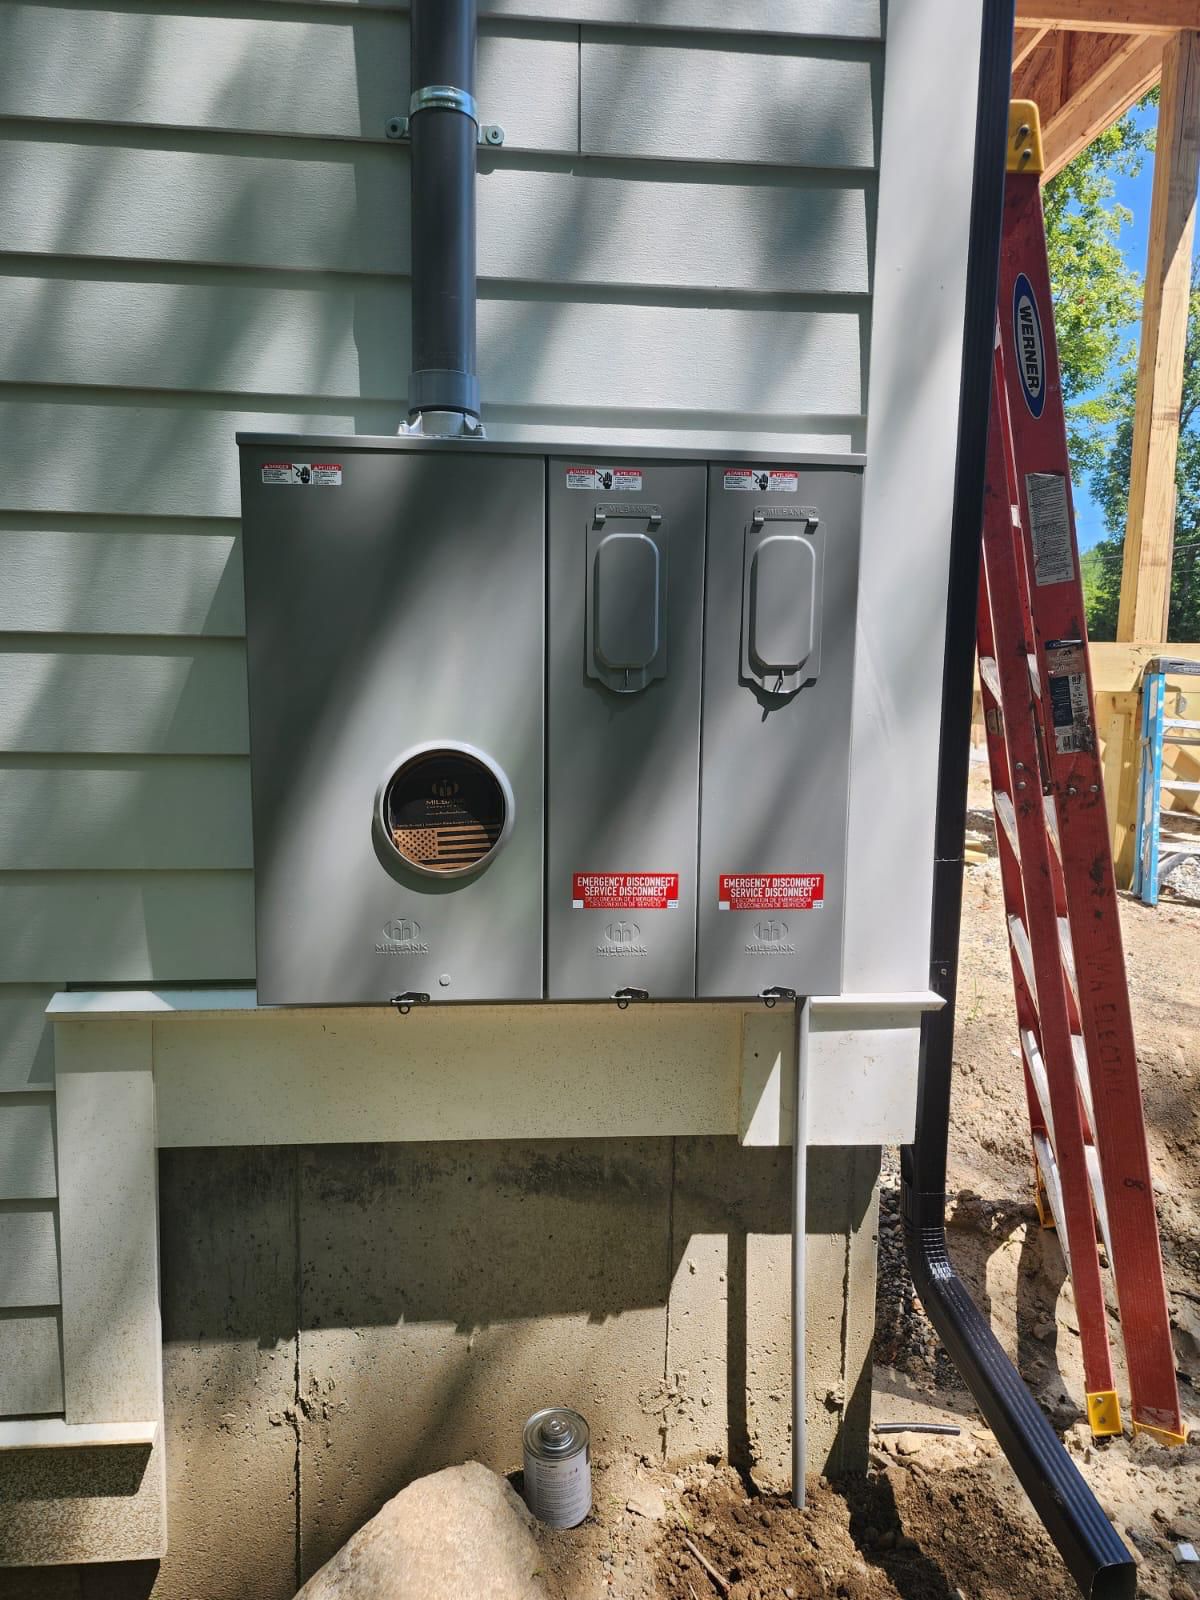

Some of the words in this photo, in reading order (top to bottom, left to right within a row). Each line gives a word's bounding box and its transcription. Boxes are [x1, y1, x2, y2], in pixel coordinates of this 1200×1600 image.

[1020, 305, 1040, 390] WERNER
[577, 876, 624, 887] EMERGENCY
[626, 876, 675, 887] DISCONNECT
[724, 878, 770, 888] EMERGENCY
[772, 877, 820, 888] DISCONNECT
[584, 886, 617, 897] SERVICE
[620, 886, 667, 897] DISCONNECT
[730, 888, 763, 897] SERVICE
[765, 887, 812, 897] DISCONNECT
[375, 943, 429, 953] MILBANK
[596, 945, 648, 953] MILBANK
[745, 944, 795, 953] MILBANK
